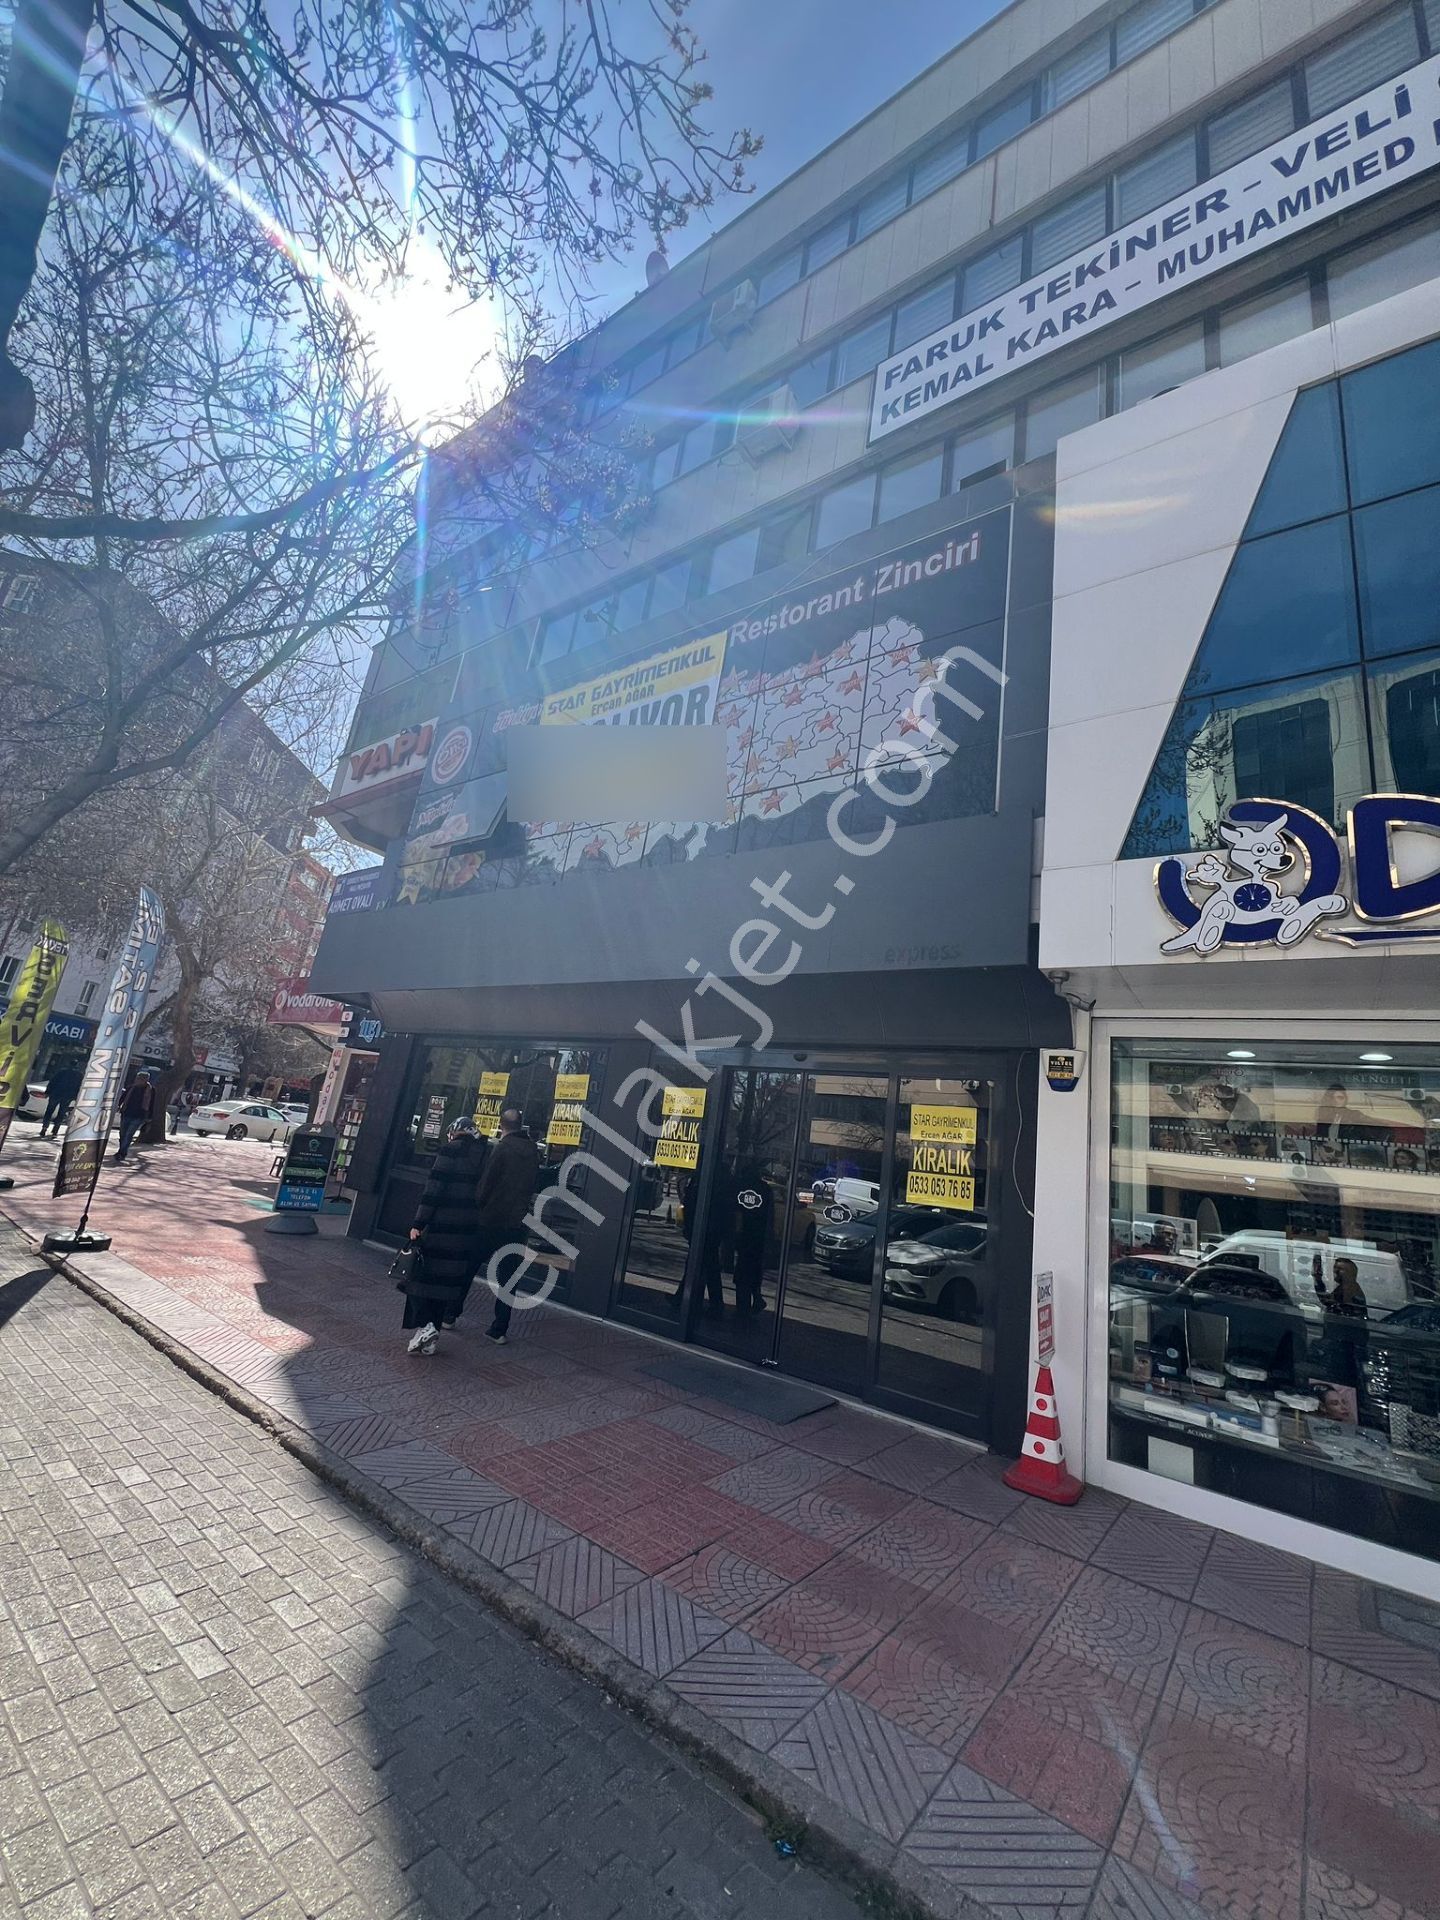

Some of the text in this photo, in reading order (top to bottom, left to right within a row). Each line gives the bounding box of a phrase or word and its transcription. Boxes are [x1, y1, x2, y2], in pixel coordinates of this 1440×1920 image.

[884, 304, 1005, 391] FARUK
[1018, 186, 1228, 316] TEKİNER
[1270, 82, 1412, 179] VELİ
[879, 356, 994, 426] KEMAL
[1006, 288, 1118, 361] KARA
[1157, 135, 1416, 285] MUHAMMED
[729, 531, 980, 648] Restorant Zinciri
[548, 691, 586, 716] STAR
[591, 696, 622, 717] Ercan
[350, 725, 433, 782] YAPI
[913, 1113, 931, 1126] STAR
[920, 1130, 963, 1141] Ercan AĞAR
[912, 1141, 972, 1176] KİRALIK
[909, 1175, 971, 1199] 0533 053 76 85
